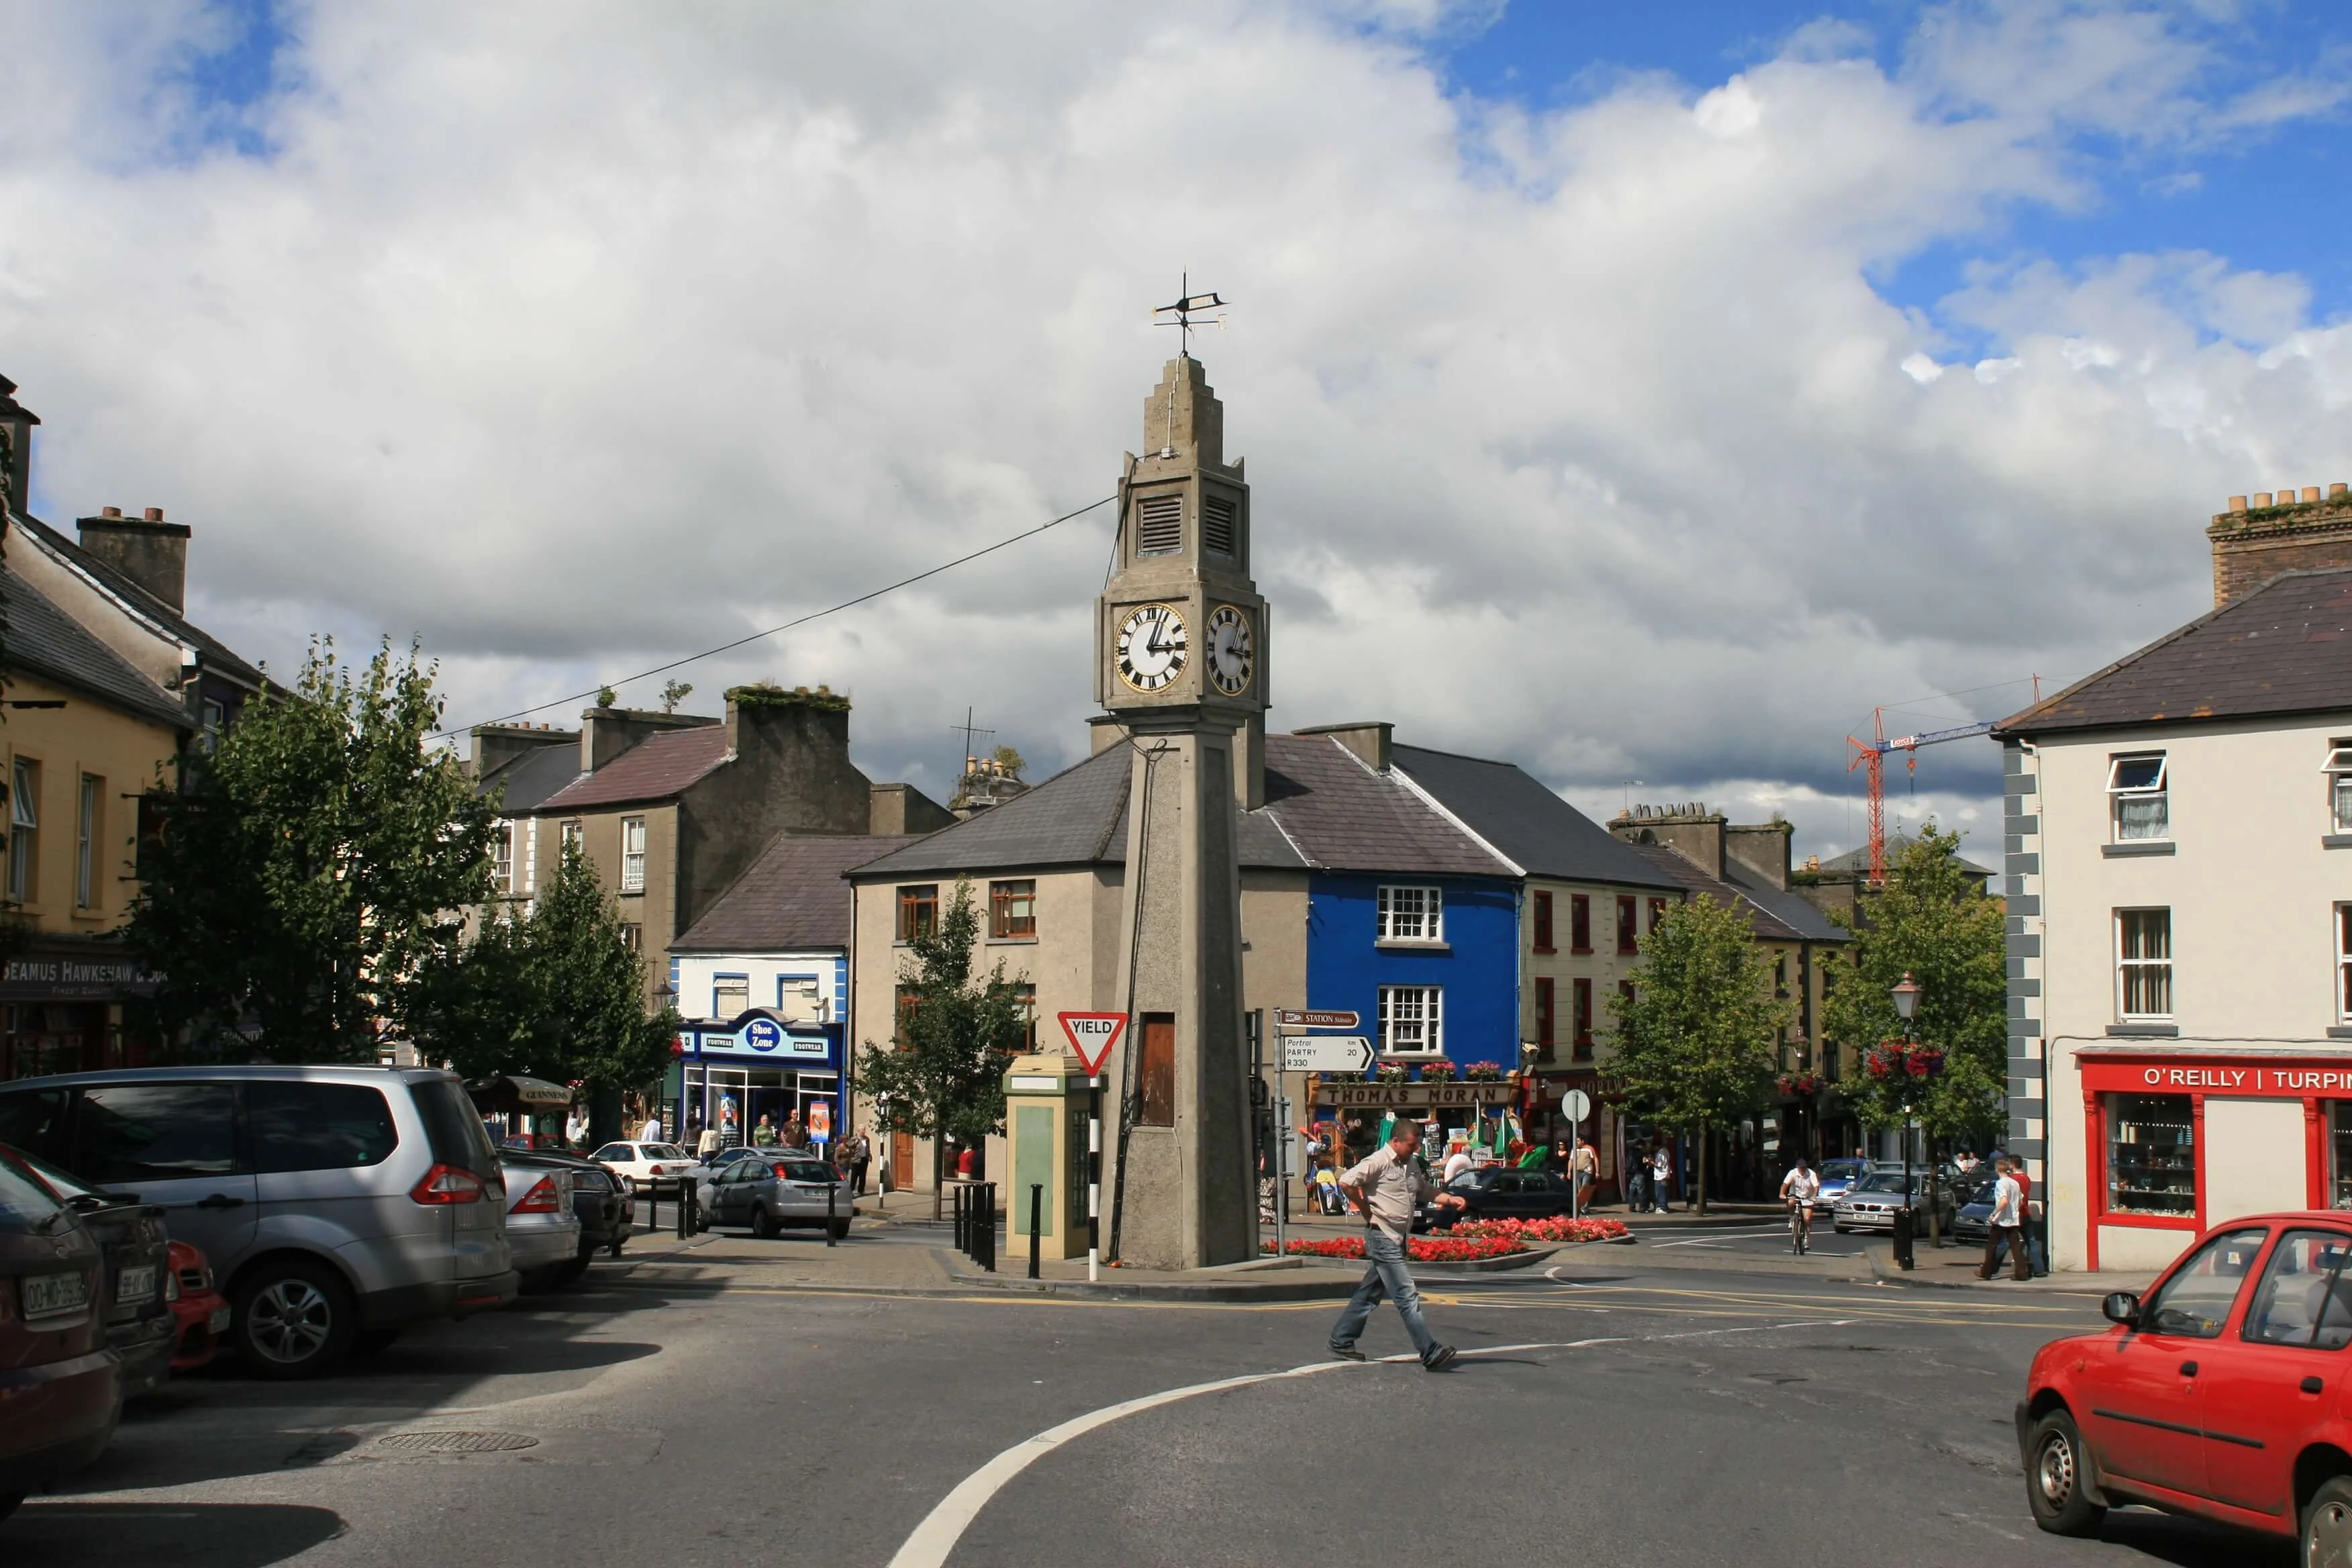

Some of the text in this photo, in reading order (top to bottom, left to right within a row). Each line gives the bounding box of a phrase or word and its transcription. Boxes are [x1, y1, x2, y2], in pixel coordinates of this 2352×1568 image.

[1306, 1014, 1334, 1023] STATION
[752, 1024, 772, 1034] Shoe
[1072, 1021, 1112, 1034] YIELD
[752, 1036, 773, 1047] Zone
[795, 1042, 822, 1050] FOOTWEAR
[2144, 1068, 2246, 1087] O'REILLY
[526, 1090, 569, 1100] GUINNESS
[1328, 1089, 1496, 1103] THOMAS MORAN
